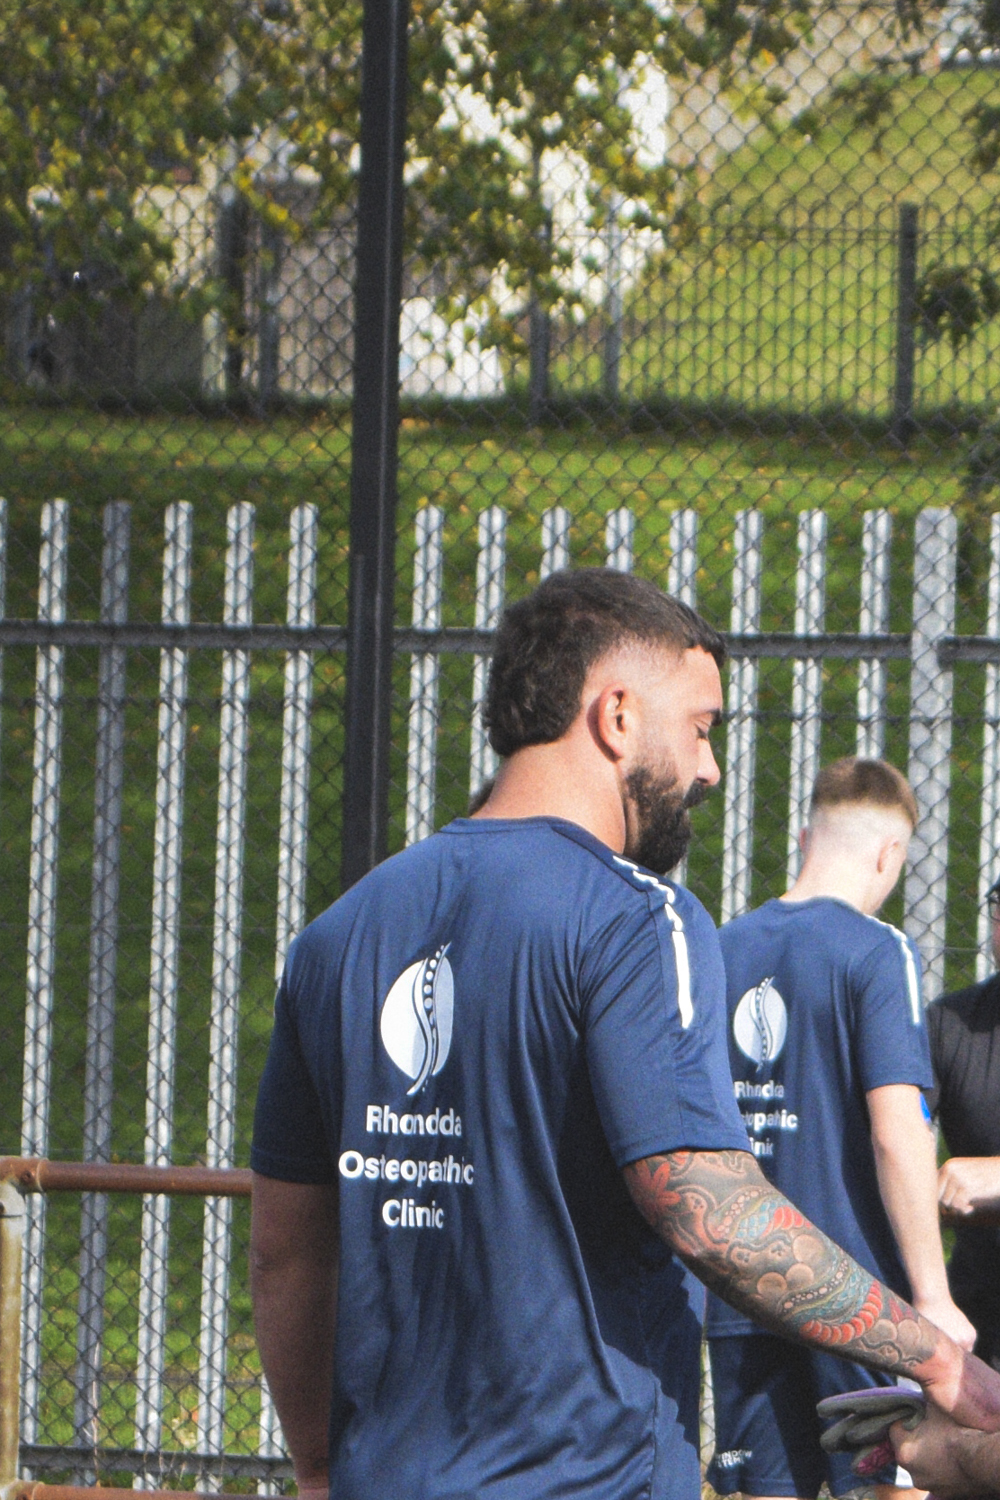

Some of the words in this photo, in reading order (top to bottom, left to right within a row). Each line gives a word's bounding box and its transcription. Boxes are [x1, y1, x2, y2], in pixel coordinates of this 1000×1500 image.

[366, 1104, 462, 1136] Rhondda
[338, 1150, 474, 1187] Osteopathic
[382, 1199, 444, 1229] Clinic
